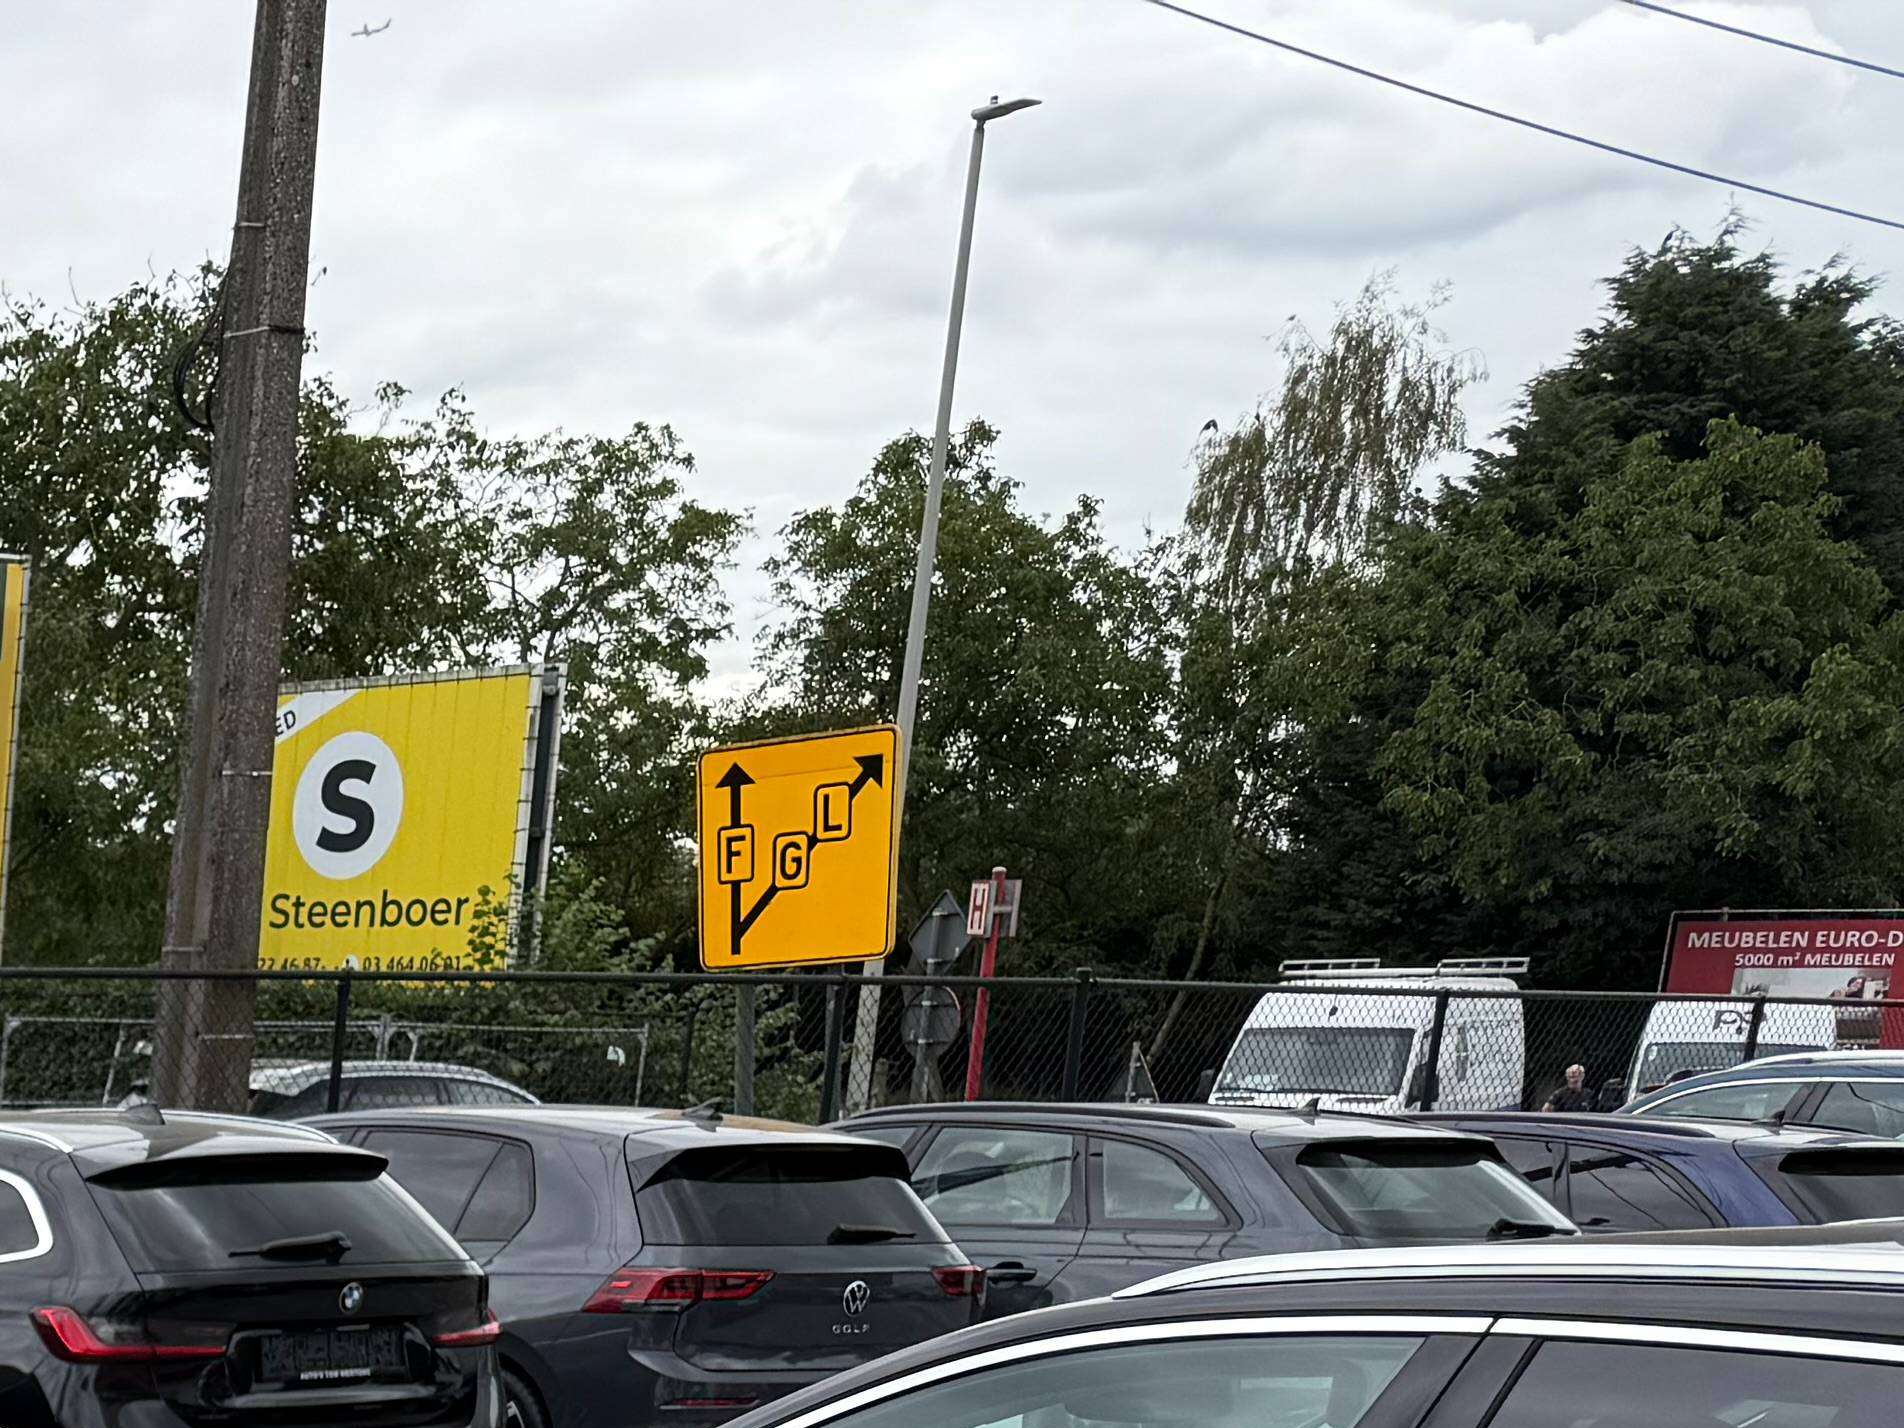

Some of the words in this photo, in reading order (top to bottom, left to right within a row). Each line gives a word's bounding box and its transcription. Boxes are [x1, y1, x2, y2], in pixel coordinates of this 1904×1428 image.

[274, 710, 296, 737] ED
[316, 759, 377, 853] S
[823, 794, 842, 830] L
[726, 835, 746, 874] F
[780, 842, 803, 880] G
[268, 889, 470, 929] Steenboer
[1688, 931, 1809, 948] MEUBELEN
[1815, 930, 1904, 948] EURO-D
[1734, 953, 1774, 967] 5000
[1804, 953, 1896, 966] MEUBELEN
